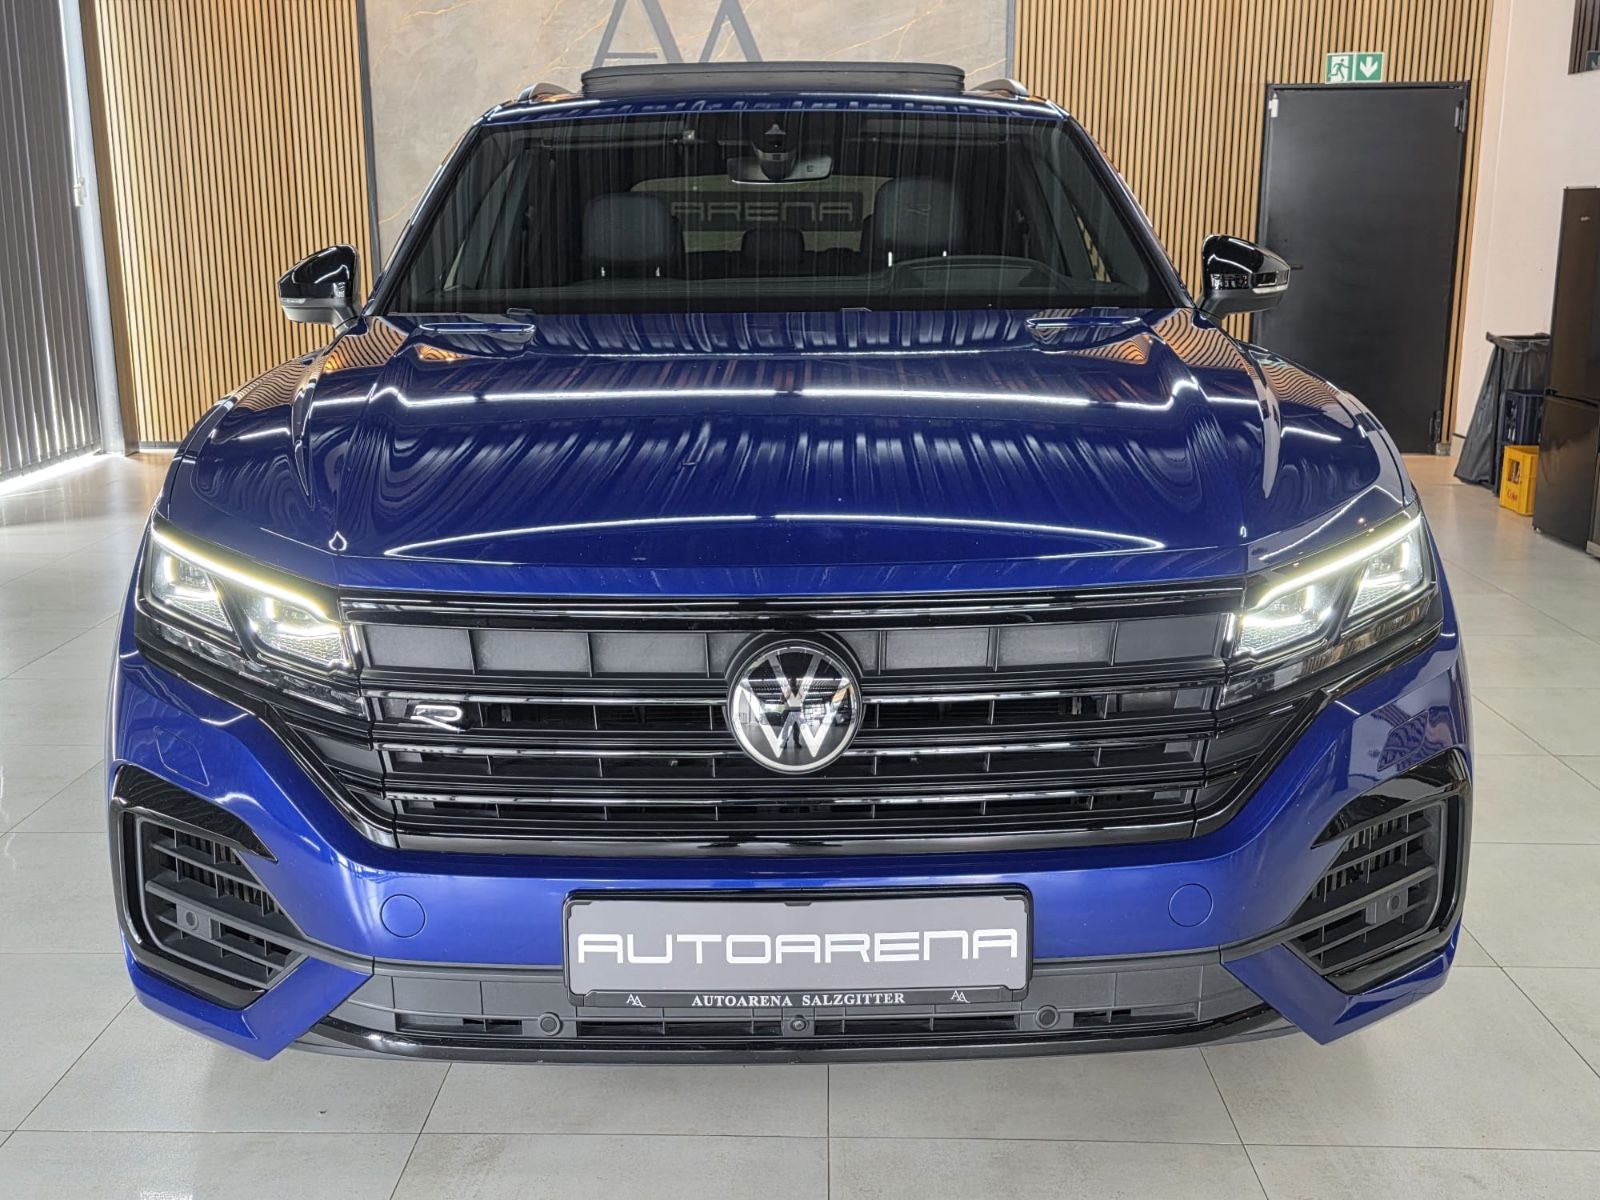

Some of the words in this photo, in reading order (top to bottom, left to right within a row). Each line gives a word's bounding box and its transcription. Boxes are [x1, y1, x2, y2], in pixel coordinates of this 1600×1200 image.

[410, 704, 466, 732] R
[578, 928, 1018, 964] AUTOARENA
[691, 994, 792, 1007] AUTOARENA
[802, 992, 905, 1006] SALZGITTER
